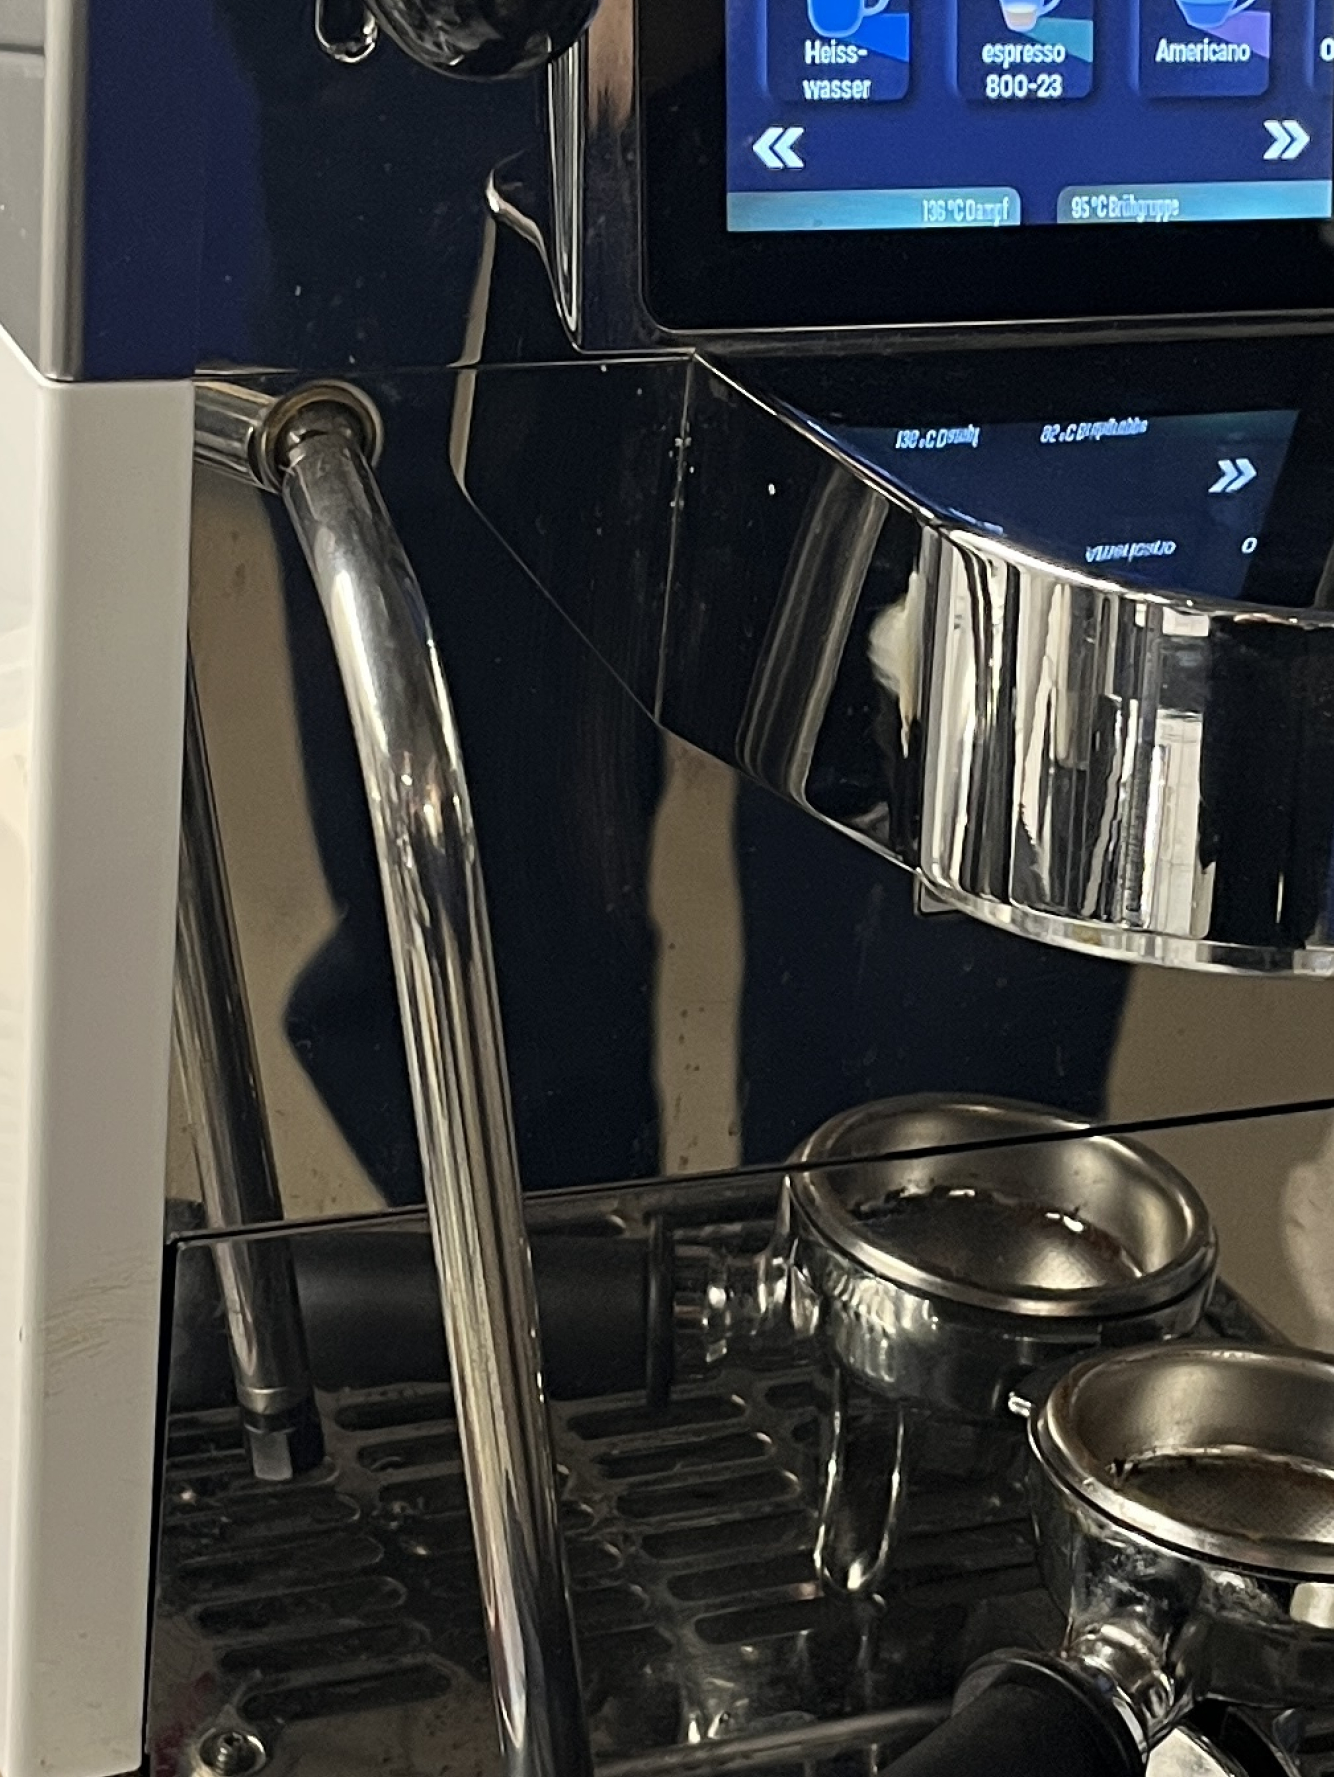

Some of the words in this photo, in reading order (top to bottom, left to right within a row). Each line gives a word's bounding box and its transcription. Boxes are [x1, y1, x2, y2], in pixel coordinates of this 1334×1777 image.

[803, 39, 868, 64] Heiss-
[982, 42, 1066, 69] espresso
[1155, 37, 1251, 63] Americano
[802, 79, 872, 100] wasser
[985, 74, 1063, 99] 800-23
[966, 196, 1009, 227] Dampf
